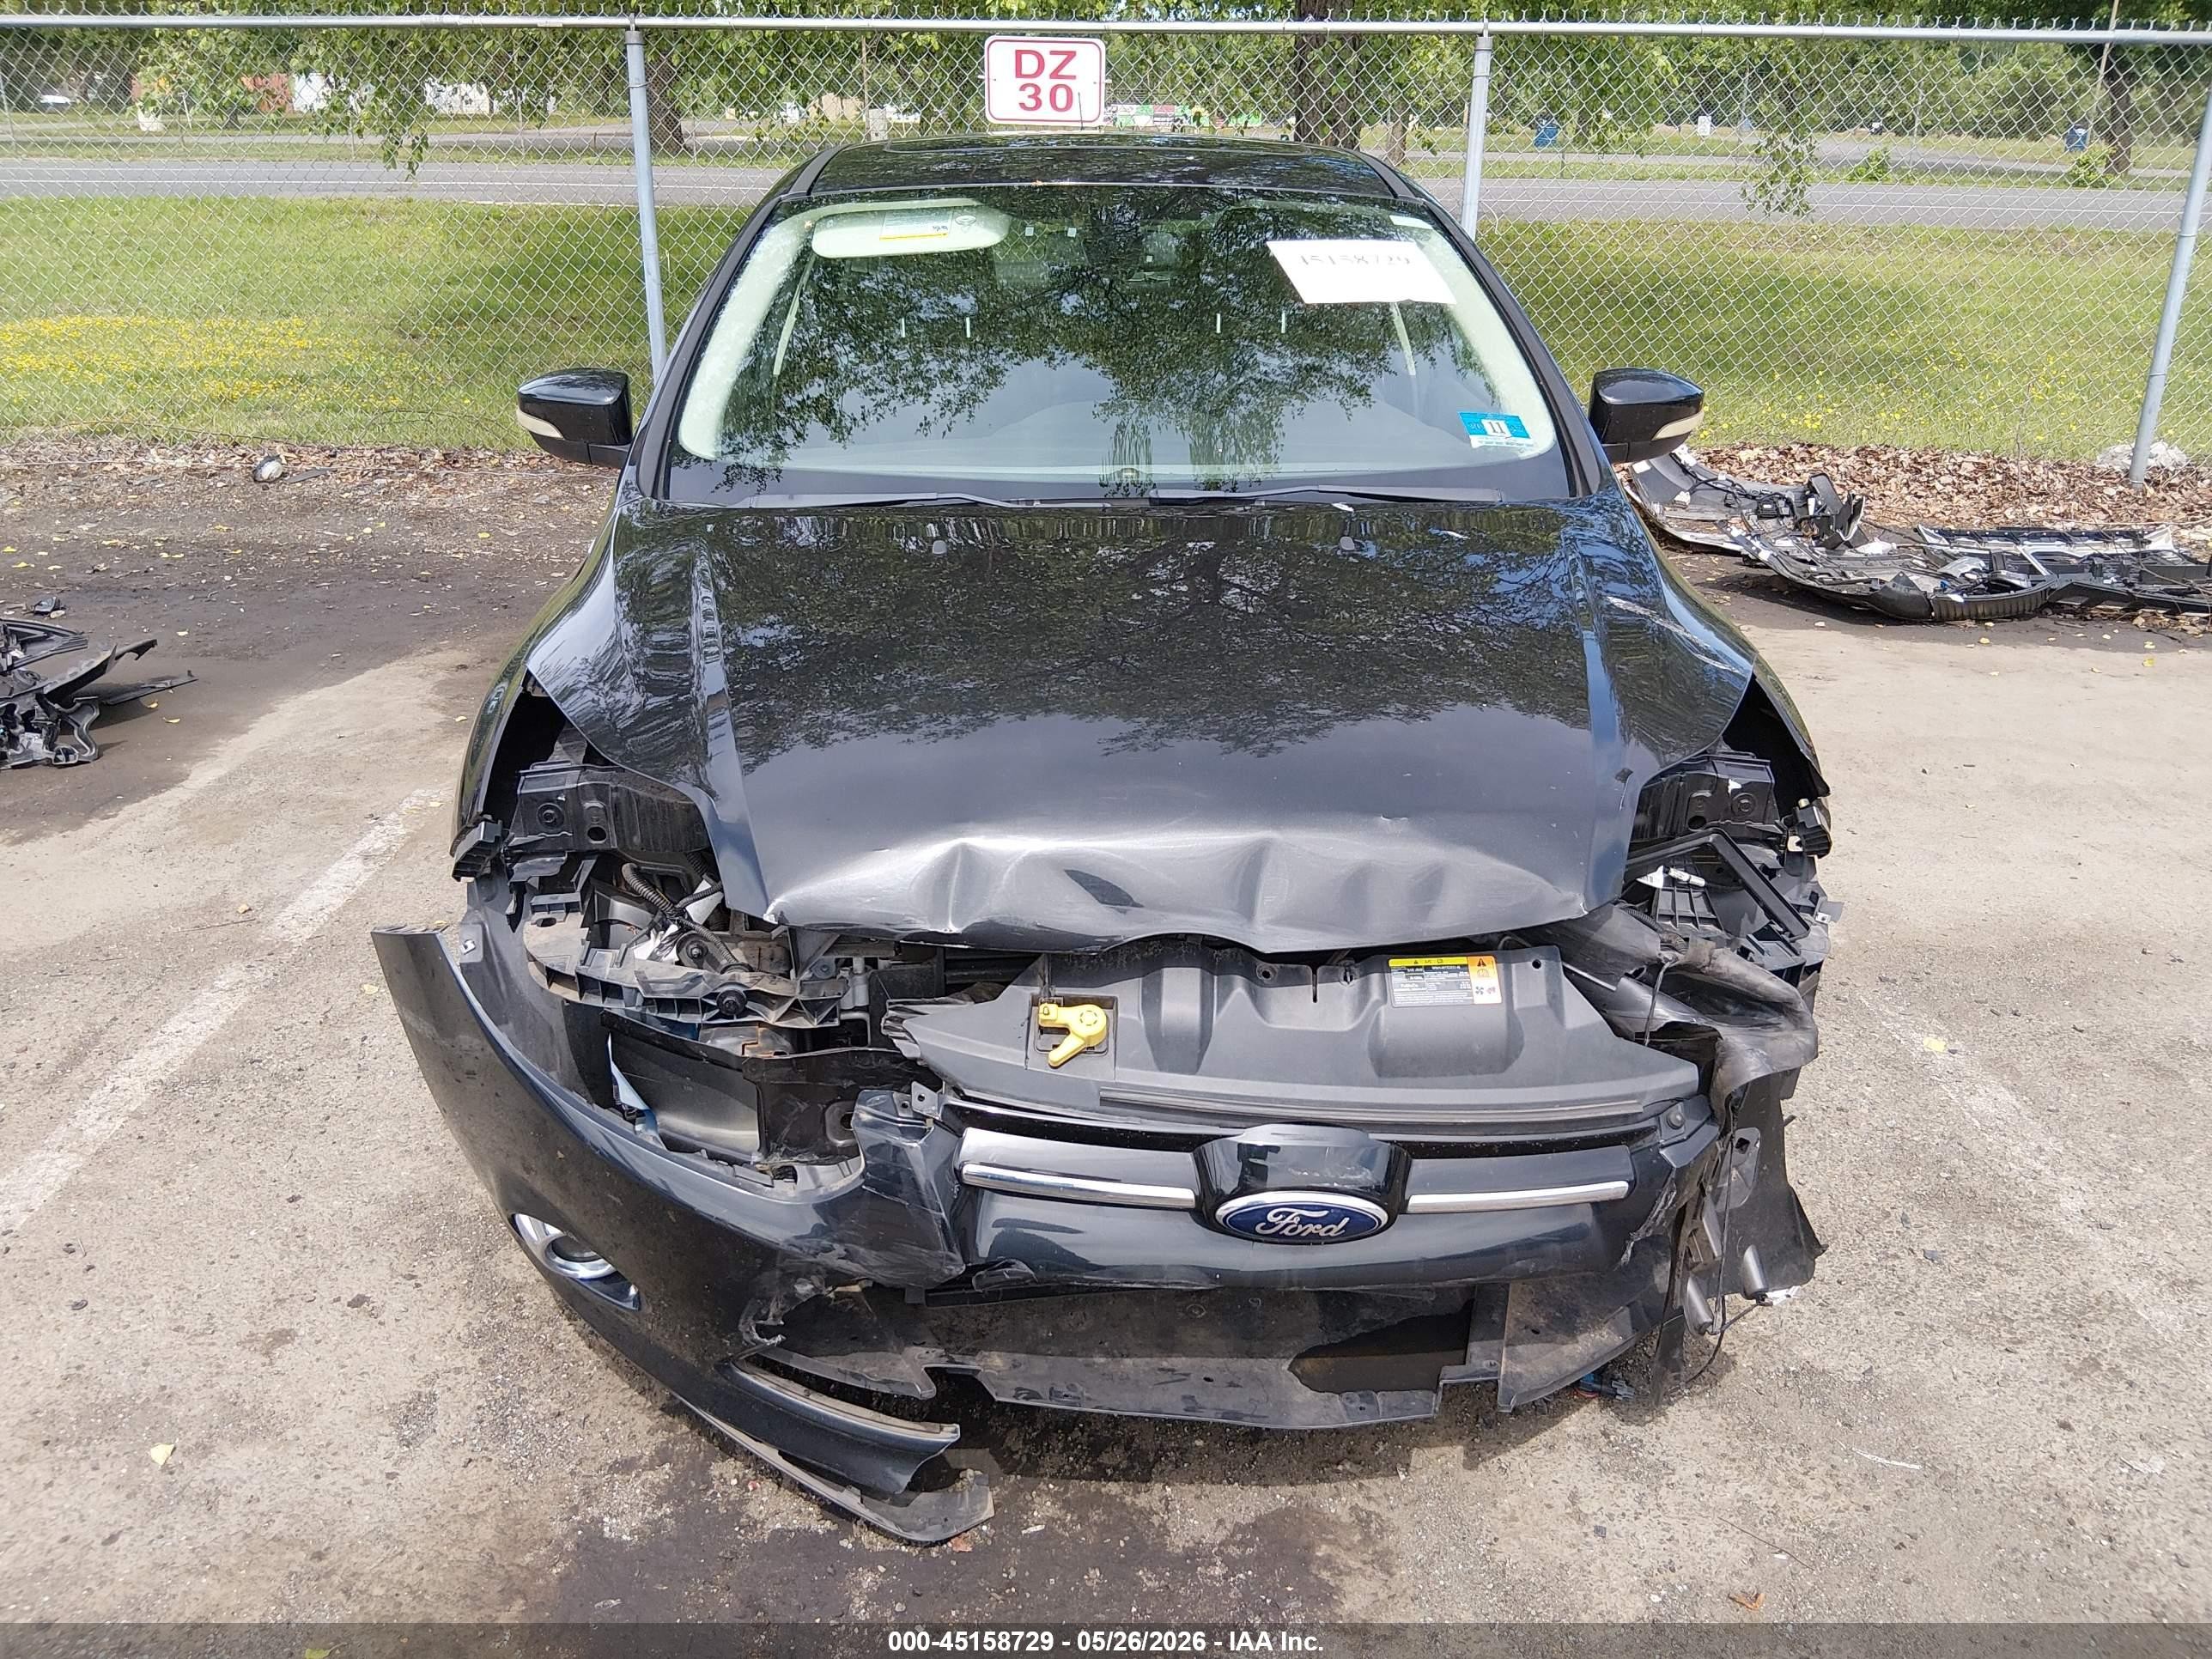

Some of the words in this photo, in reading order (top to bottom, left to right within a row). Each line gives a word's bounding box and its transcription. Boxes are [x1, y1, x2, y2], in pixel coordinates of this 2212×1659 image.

[1014, 49, 1077, 80] DZ
[1018, 82, 1073, 112] 30
[1487, 421, 1506, 434] 11
[1255, 1206, 1350, 1237] Ford
